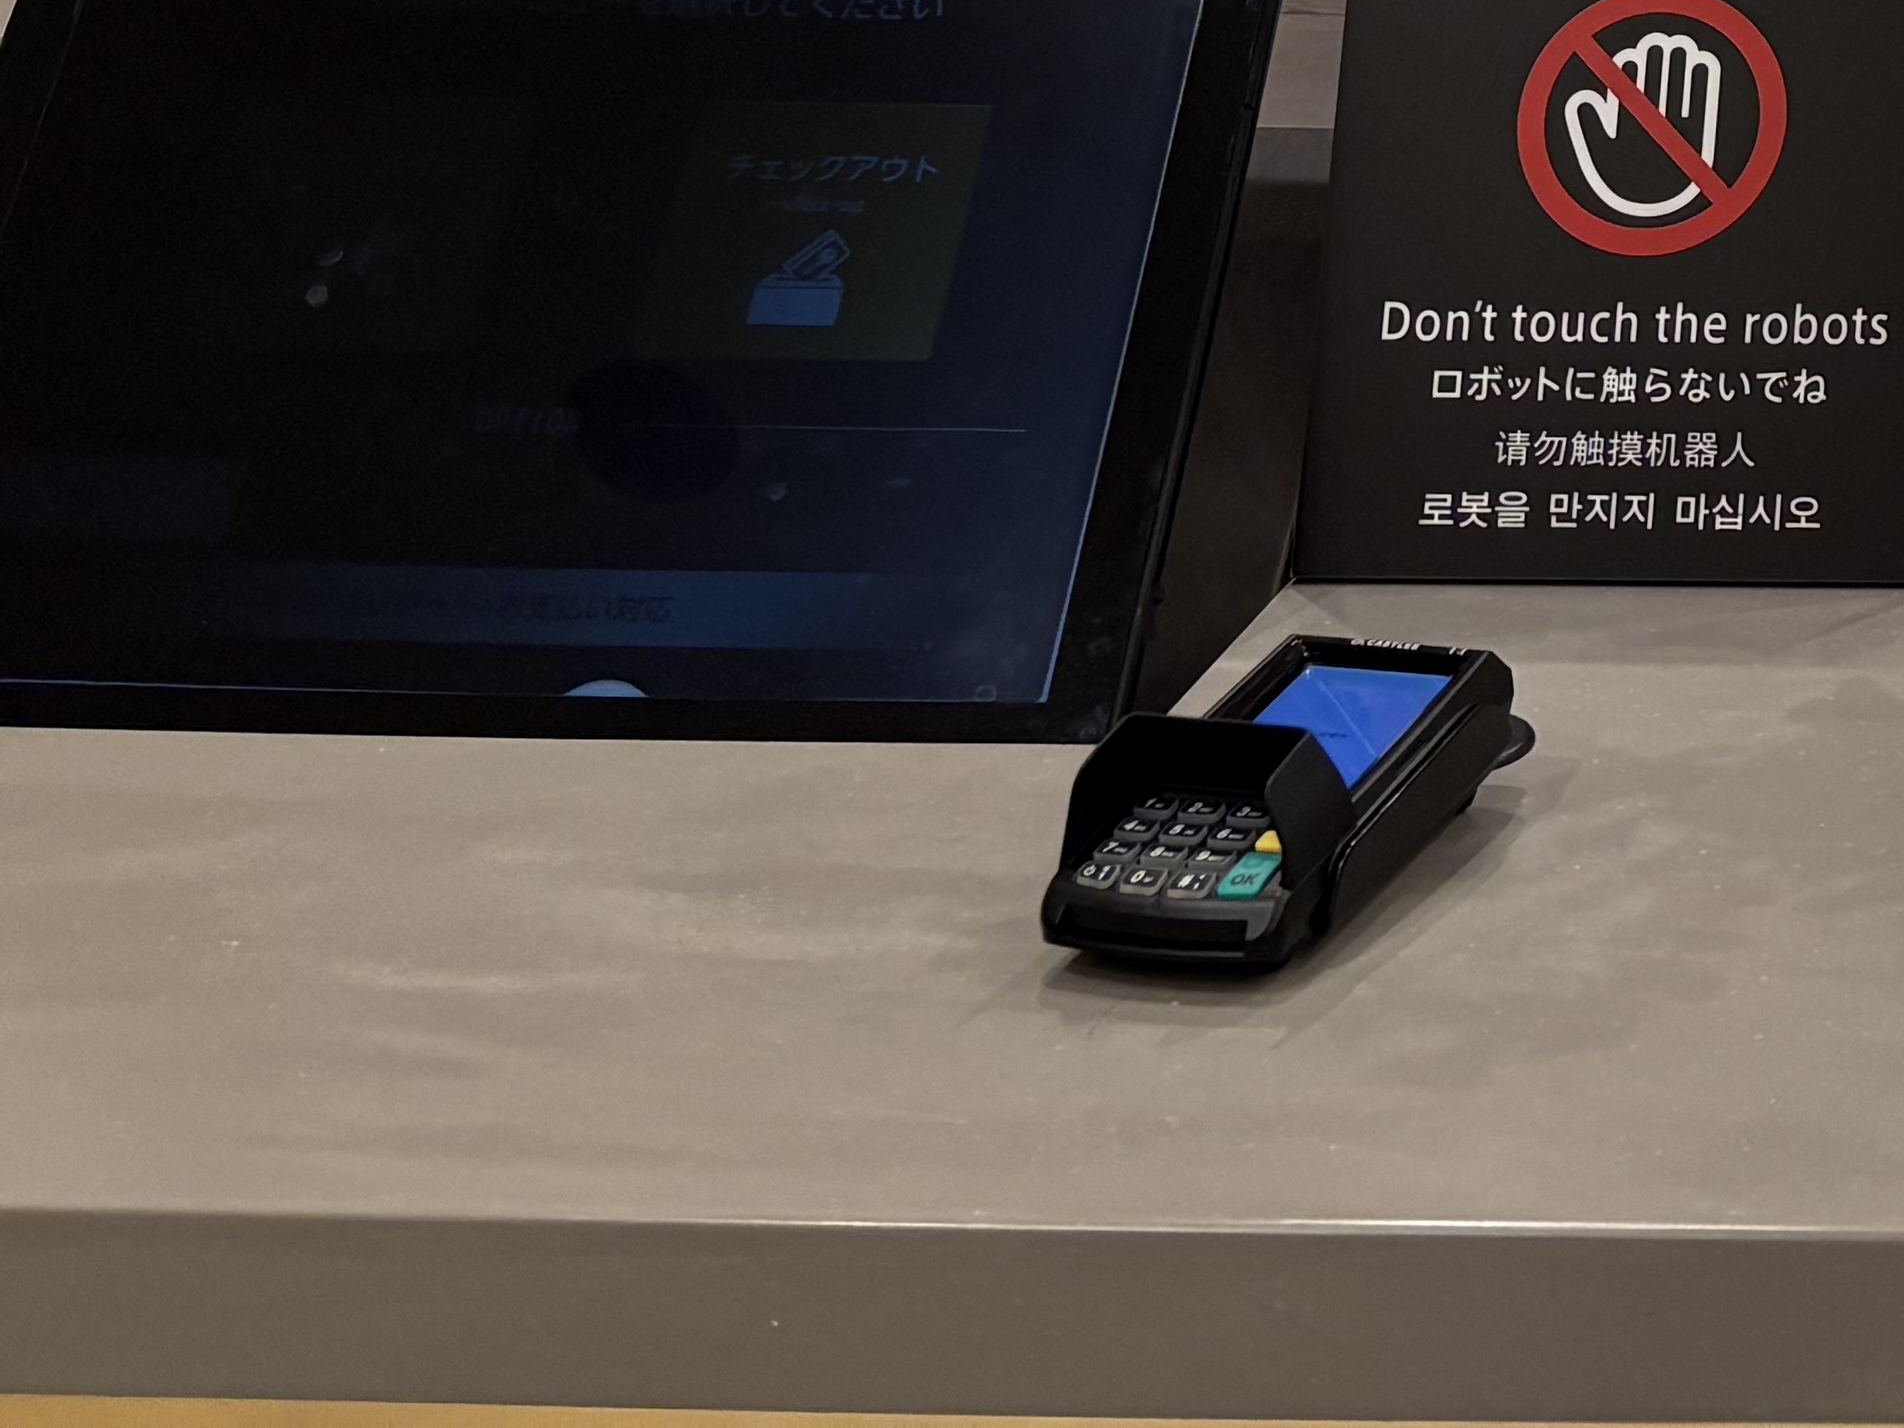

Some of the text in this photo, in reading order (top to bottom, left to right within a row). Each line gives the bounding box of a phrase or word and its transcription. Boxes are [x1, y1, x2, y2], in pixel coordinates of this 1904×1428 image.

[727, 155, 938, 182] チェックアウト
[1381, 300, 1887, 345] Don't touch the robots
[1432, 364, 1826, 403] ロボットに触らないでね
[1494, 429, 1754, 467] 请勿触摸机器人
[1418, 490, 1820, 530] 로봇을 만지지 마십시오
[1231, 872, 1260, 885] OK
